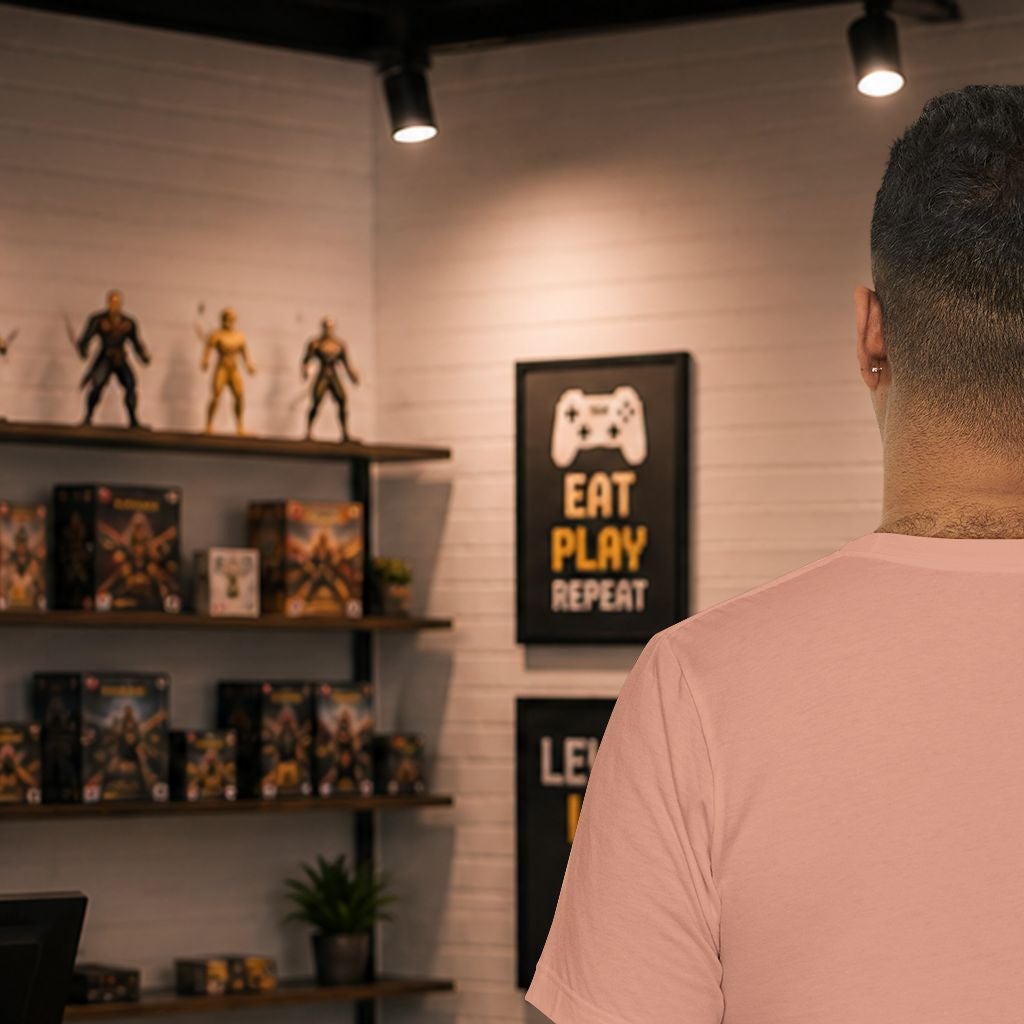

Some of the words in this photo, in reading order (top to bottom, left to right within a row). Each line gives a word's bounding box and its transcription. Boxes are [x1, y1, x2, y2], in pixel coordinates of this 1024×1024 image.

[563, 471, 636, 519] EAT
[551, 525, 648, 572] PLAY
[551, 578, 649, 612] REPEAT
